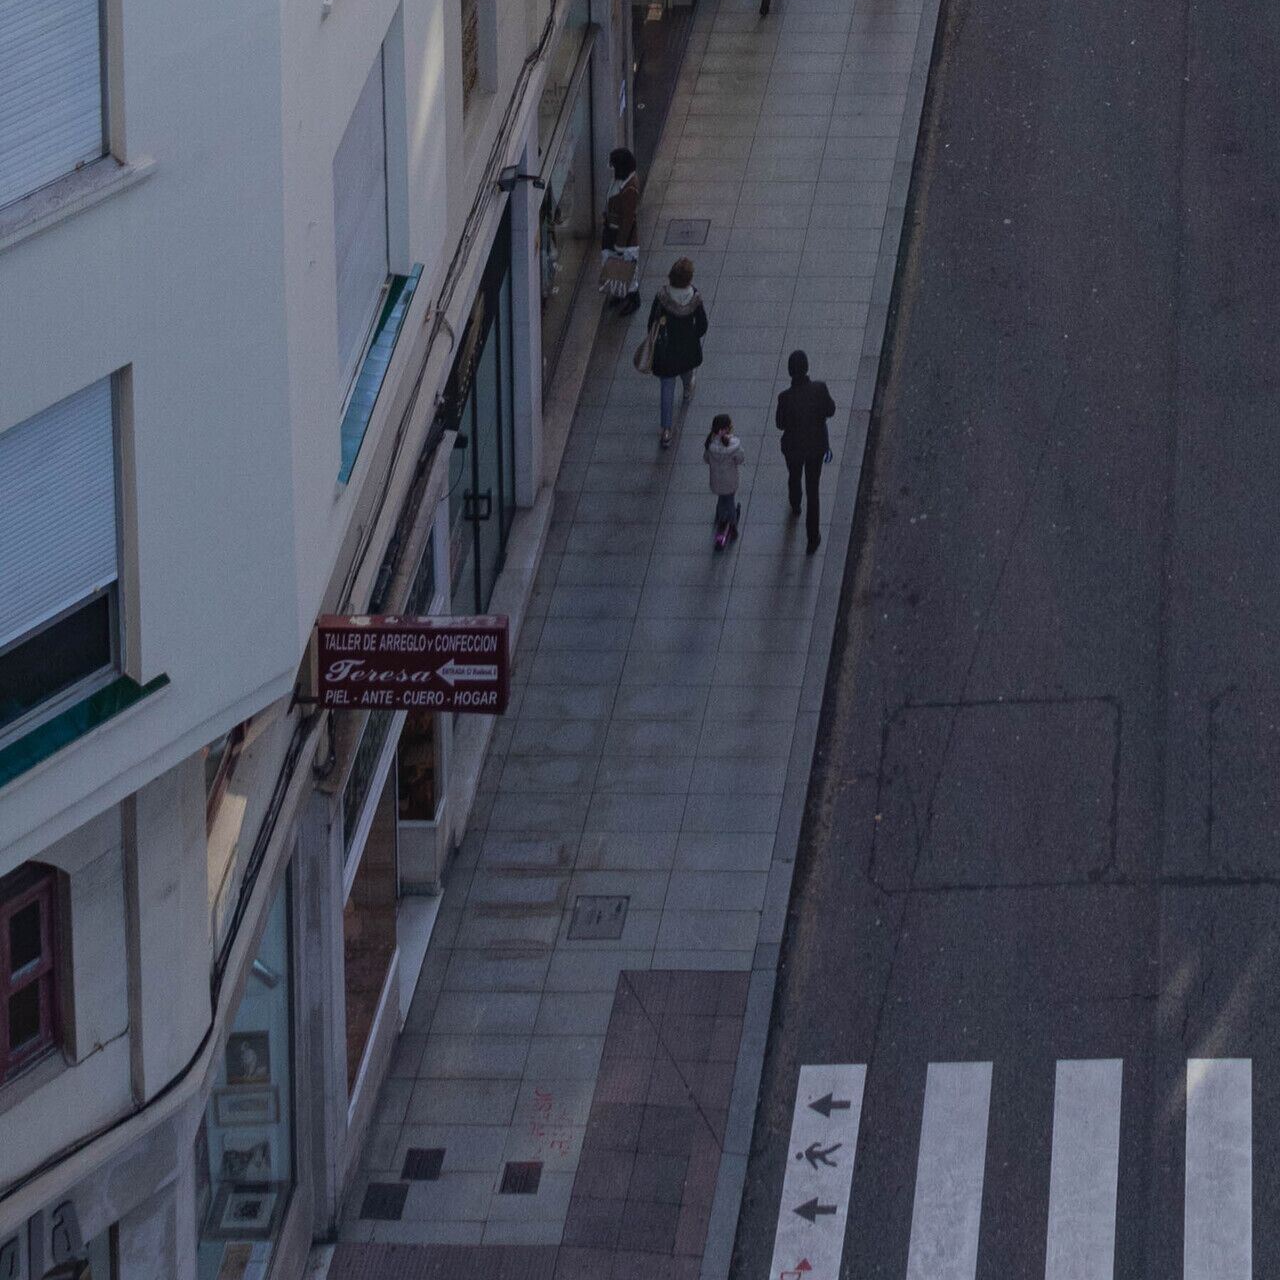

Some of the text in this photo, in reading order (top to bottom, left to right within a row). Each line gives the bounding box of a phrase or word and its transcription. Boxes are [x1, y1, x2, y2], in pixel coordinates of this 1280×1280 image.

[324, 633, 362, 651] TALLER
[363, 634, 377, 651] DE
[379, 634, 426, 652] ARREGLO
[434, 635, 498, 652] CONFECCION
[324, 659, 433, 682] Teresa
[324, 689, 498, 705] PIEL ANTE CUERO HOGAR
